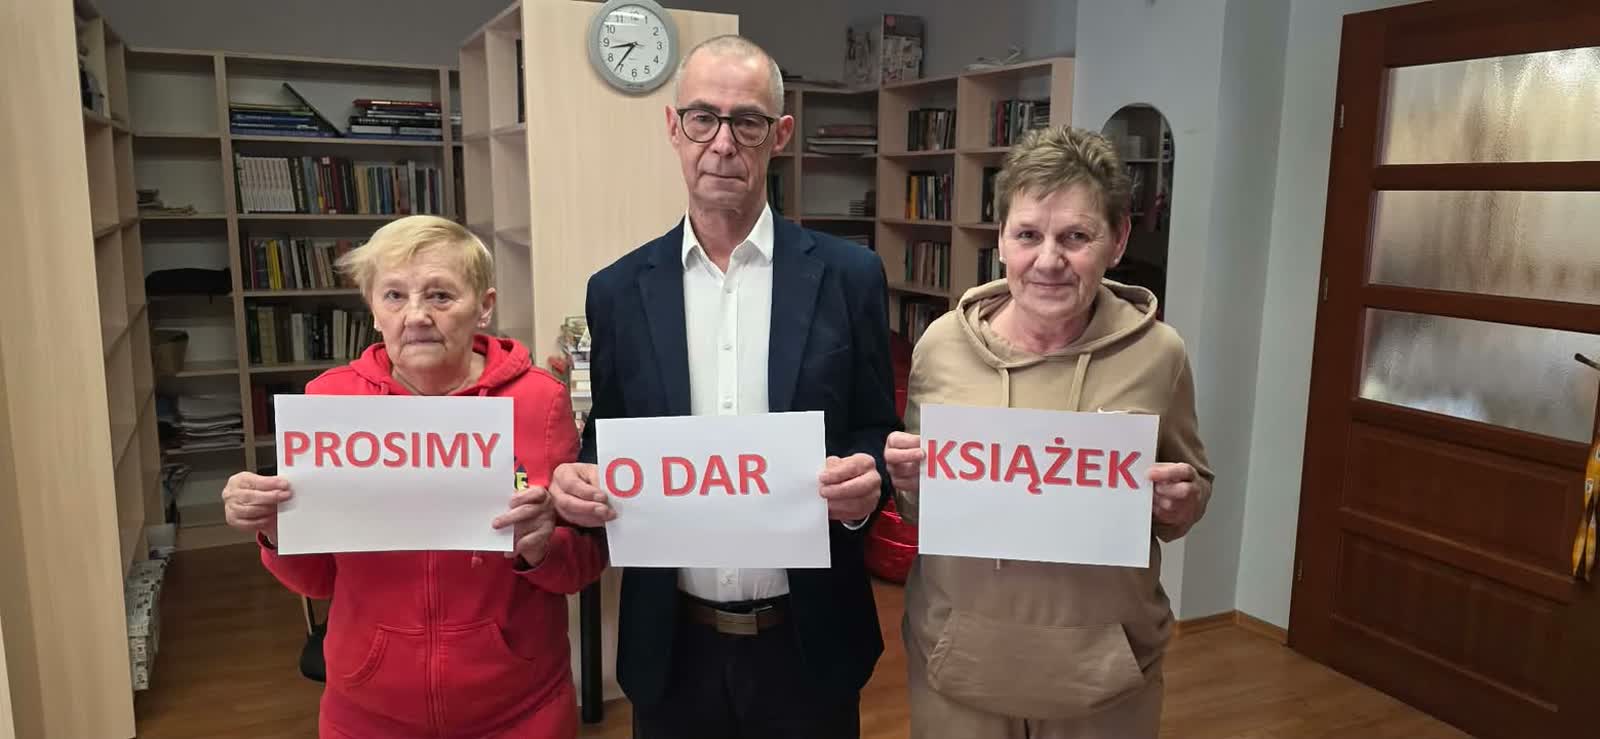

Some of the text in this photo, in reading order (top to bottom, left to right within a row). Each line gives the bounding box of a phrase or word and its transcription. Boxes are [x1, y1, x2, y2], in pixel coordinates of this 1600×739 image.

[615, 15, 624, 23] 11
[644, 16, 648, 24] 1
[606, 25, 616, 34] 10
[652, 27, 659, 36] 2
[603, 38, 610, 47] 9
[656, 41, 662, 50] 3
[608, 53, 614, 62] 8
[653, 56, 659, 64] 4
[631, 68, 637, 78] 6
[644, 65, 650, 74] 5
[284, 431, 500, 468] PROSIMY
[927, 437, 1141, 494] KSIĄŻEK
[605, 454, 769, 499] O DAR
